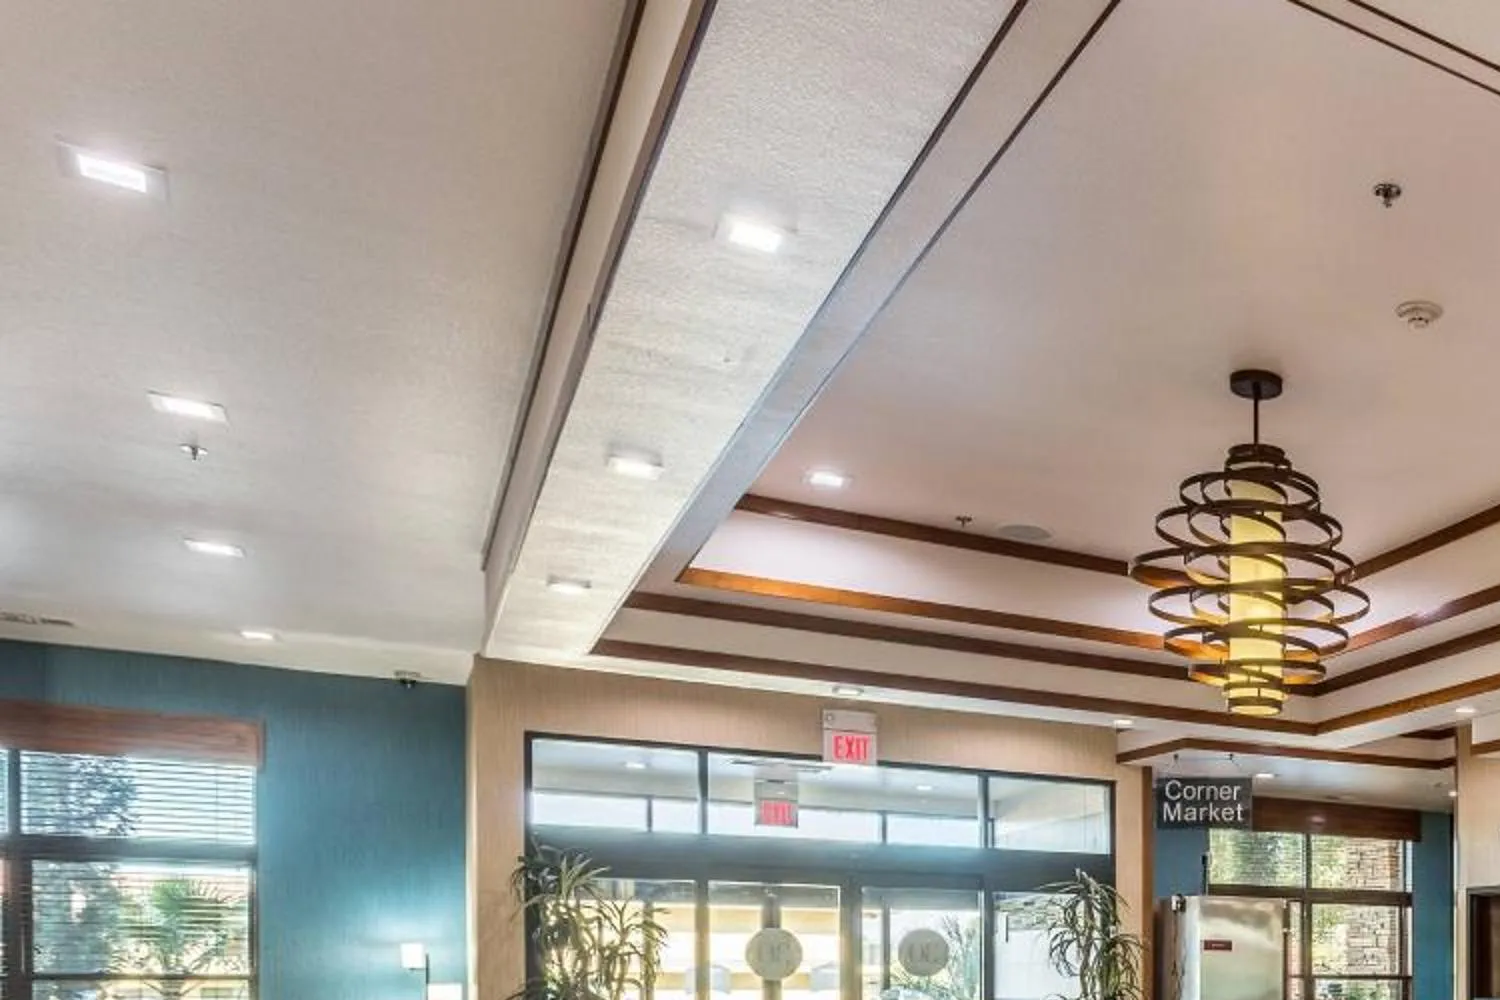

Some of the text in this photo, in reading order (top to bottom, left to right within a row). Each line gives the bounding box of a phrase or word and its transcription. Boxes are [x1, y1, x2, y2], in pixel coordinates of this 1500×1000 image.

[833, 735, 869, 760] EXIT
[1165, 779, 1241, 801] Corner
[1163, 802, 1244, 822] Market
